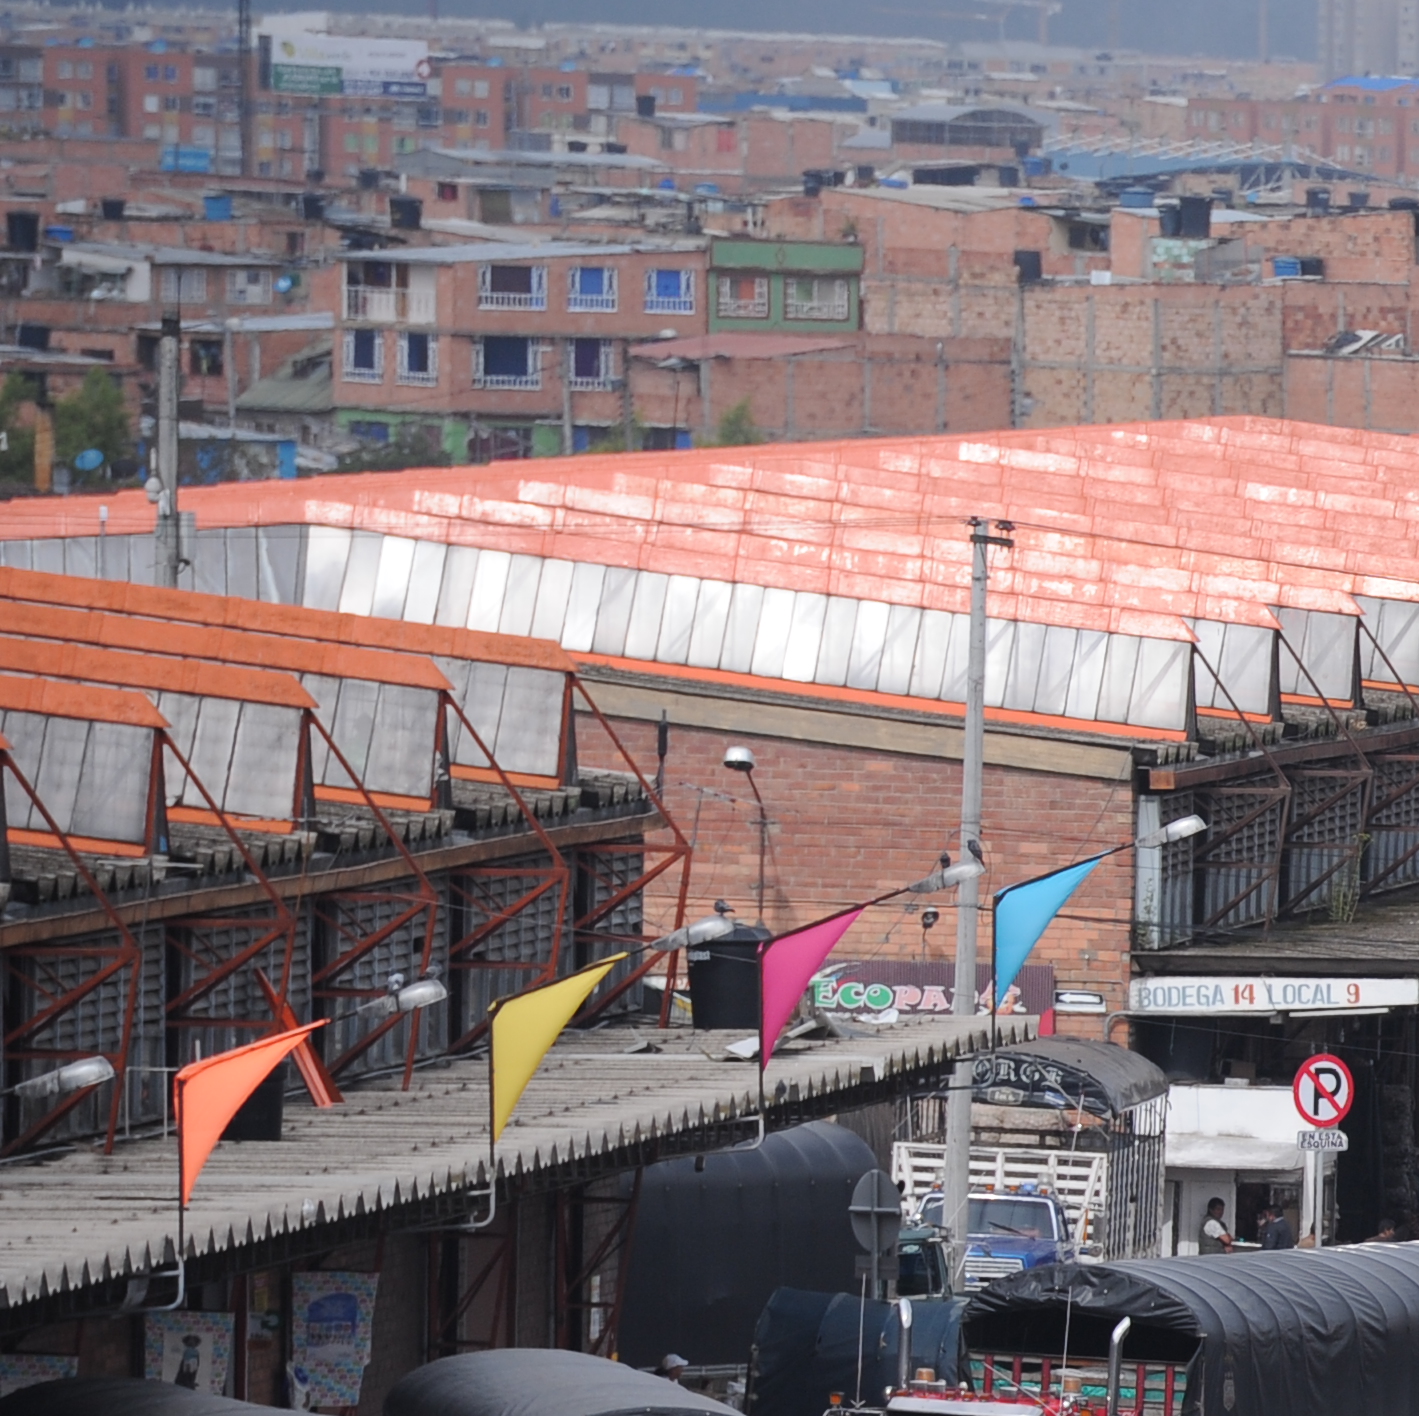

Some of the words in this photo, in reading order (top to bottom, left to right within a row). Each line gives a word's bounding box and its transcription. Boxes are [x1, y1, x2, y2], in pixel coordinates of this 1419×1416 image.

[1138, 983, 1226, 1008] BODEGA
[1231, 983, 1256, 1006] 14
[1267, 983, 1340, 1005] LOCAL
[1346, 983, 1361, 1005] 9
[1313, 1067, 1342, 1116] P
[1300, 1140, 1345, 1150] ESQUINA
[1301, 1132, 1315, 1141] EN
[1318, 1132, 1343, 1141] ESTA
